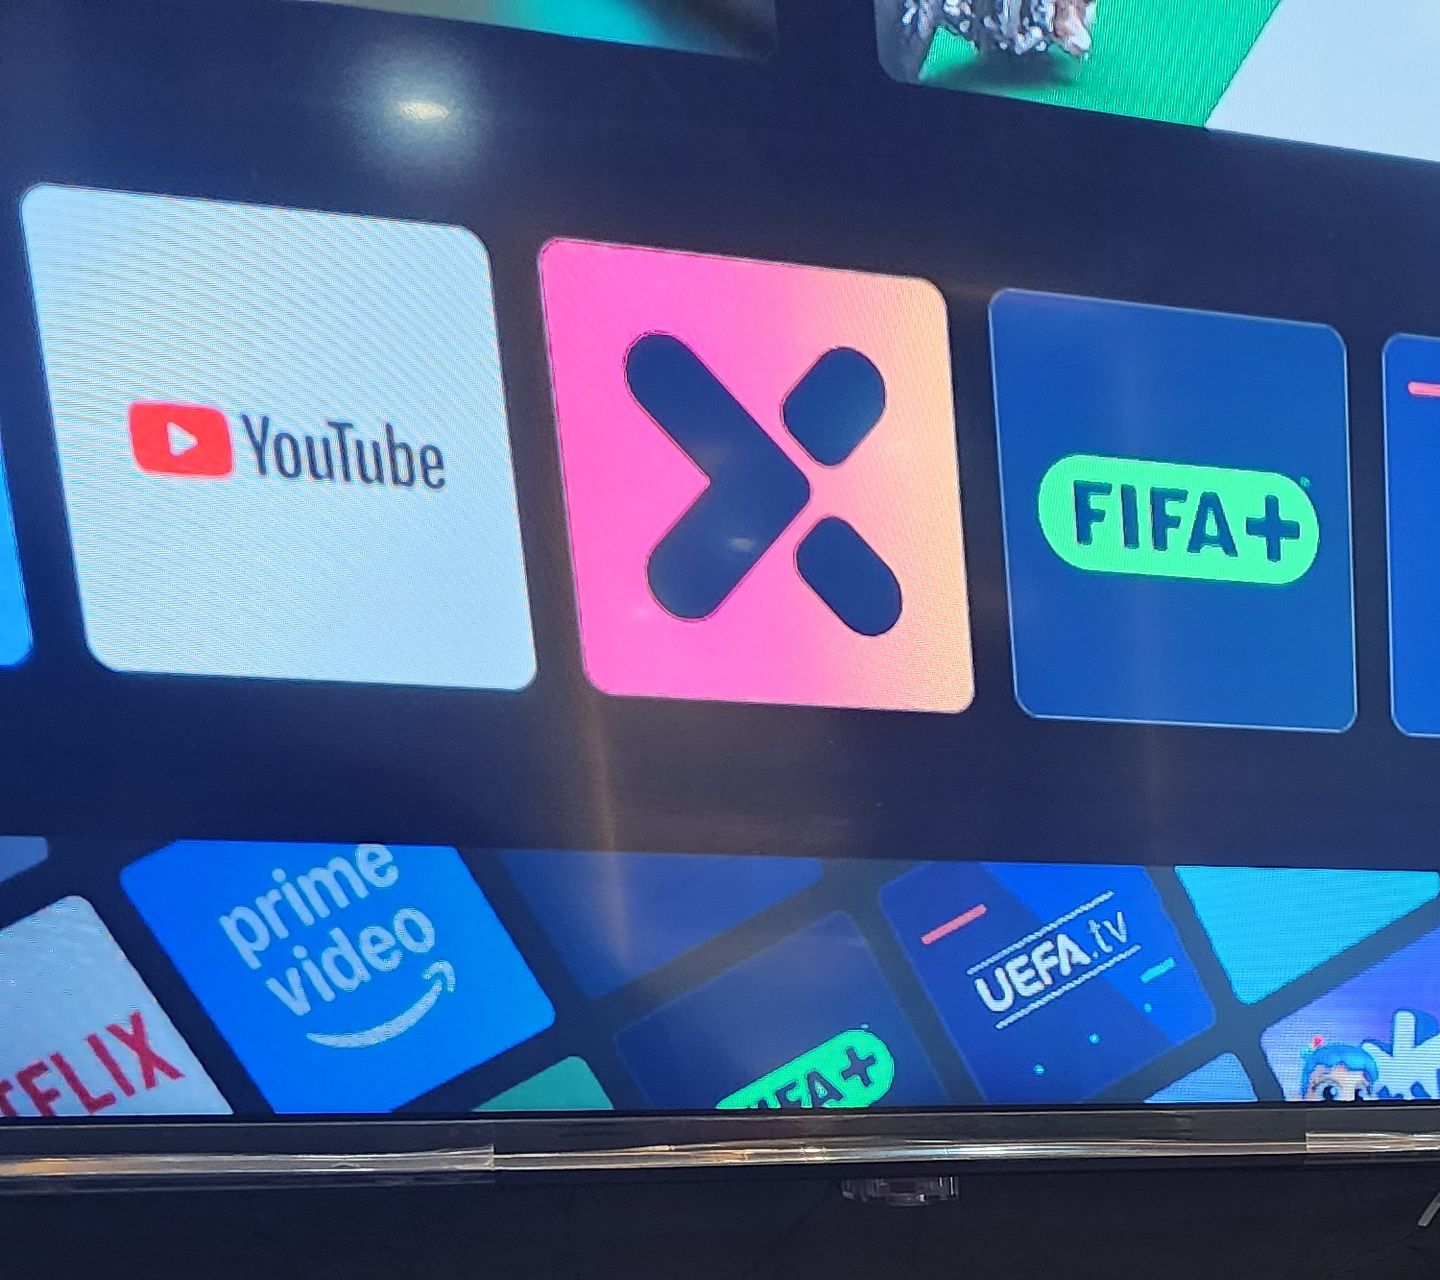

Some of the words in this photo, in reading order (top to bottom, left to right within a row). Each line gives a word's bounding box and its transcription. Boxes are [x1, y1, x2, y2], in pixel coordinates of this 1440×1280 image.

[241, 411, 446, 492] YouTube
[1072, 479, 1301, 562] FIFA+
[219, 843, 400, 970] prime
[266, 907, 437, 1016] video
[973, 911, 1128, 1012] UEFA.tv
